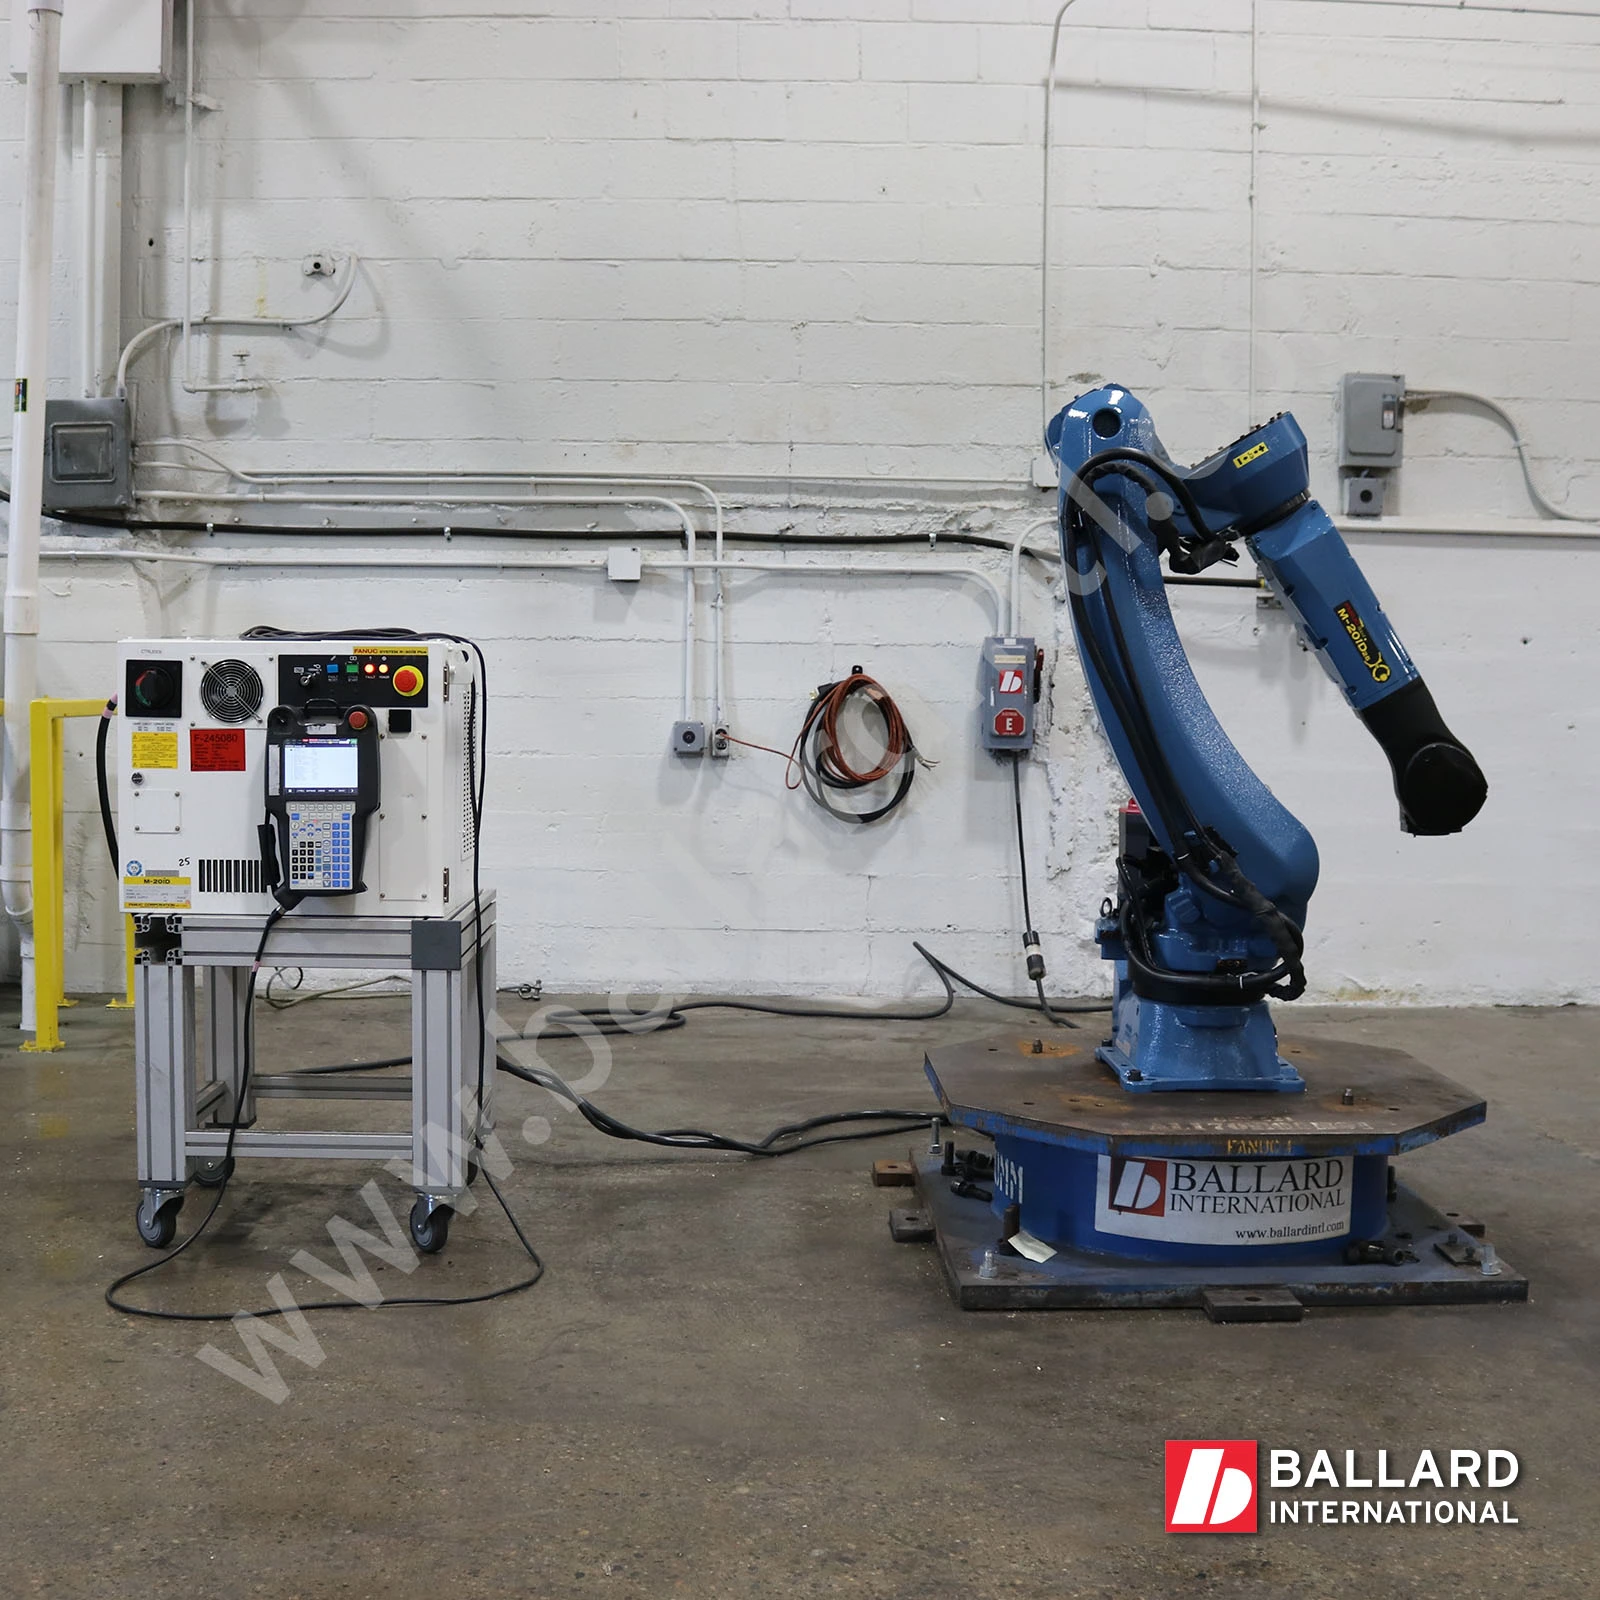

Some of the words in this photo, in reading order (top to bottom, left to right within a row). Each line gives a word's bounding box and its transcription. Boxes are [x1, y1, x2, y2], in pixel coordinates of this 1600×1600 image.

[1006, 718, 1013, 730] E
[194, 733, 238, 743] F-245080
[178, 857, 191, 867] 25
[1227, 1139, 1280, 1154] FANUC
[1171, 1159, 1344, 1193] BALLARD
[1170, 1189, 1346, 1214] INTERNATIONAL
[1235, 1220, 1345, 1239] www.ballardintl.com
